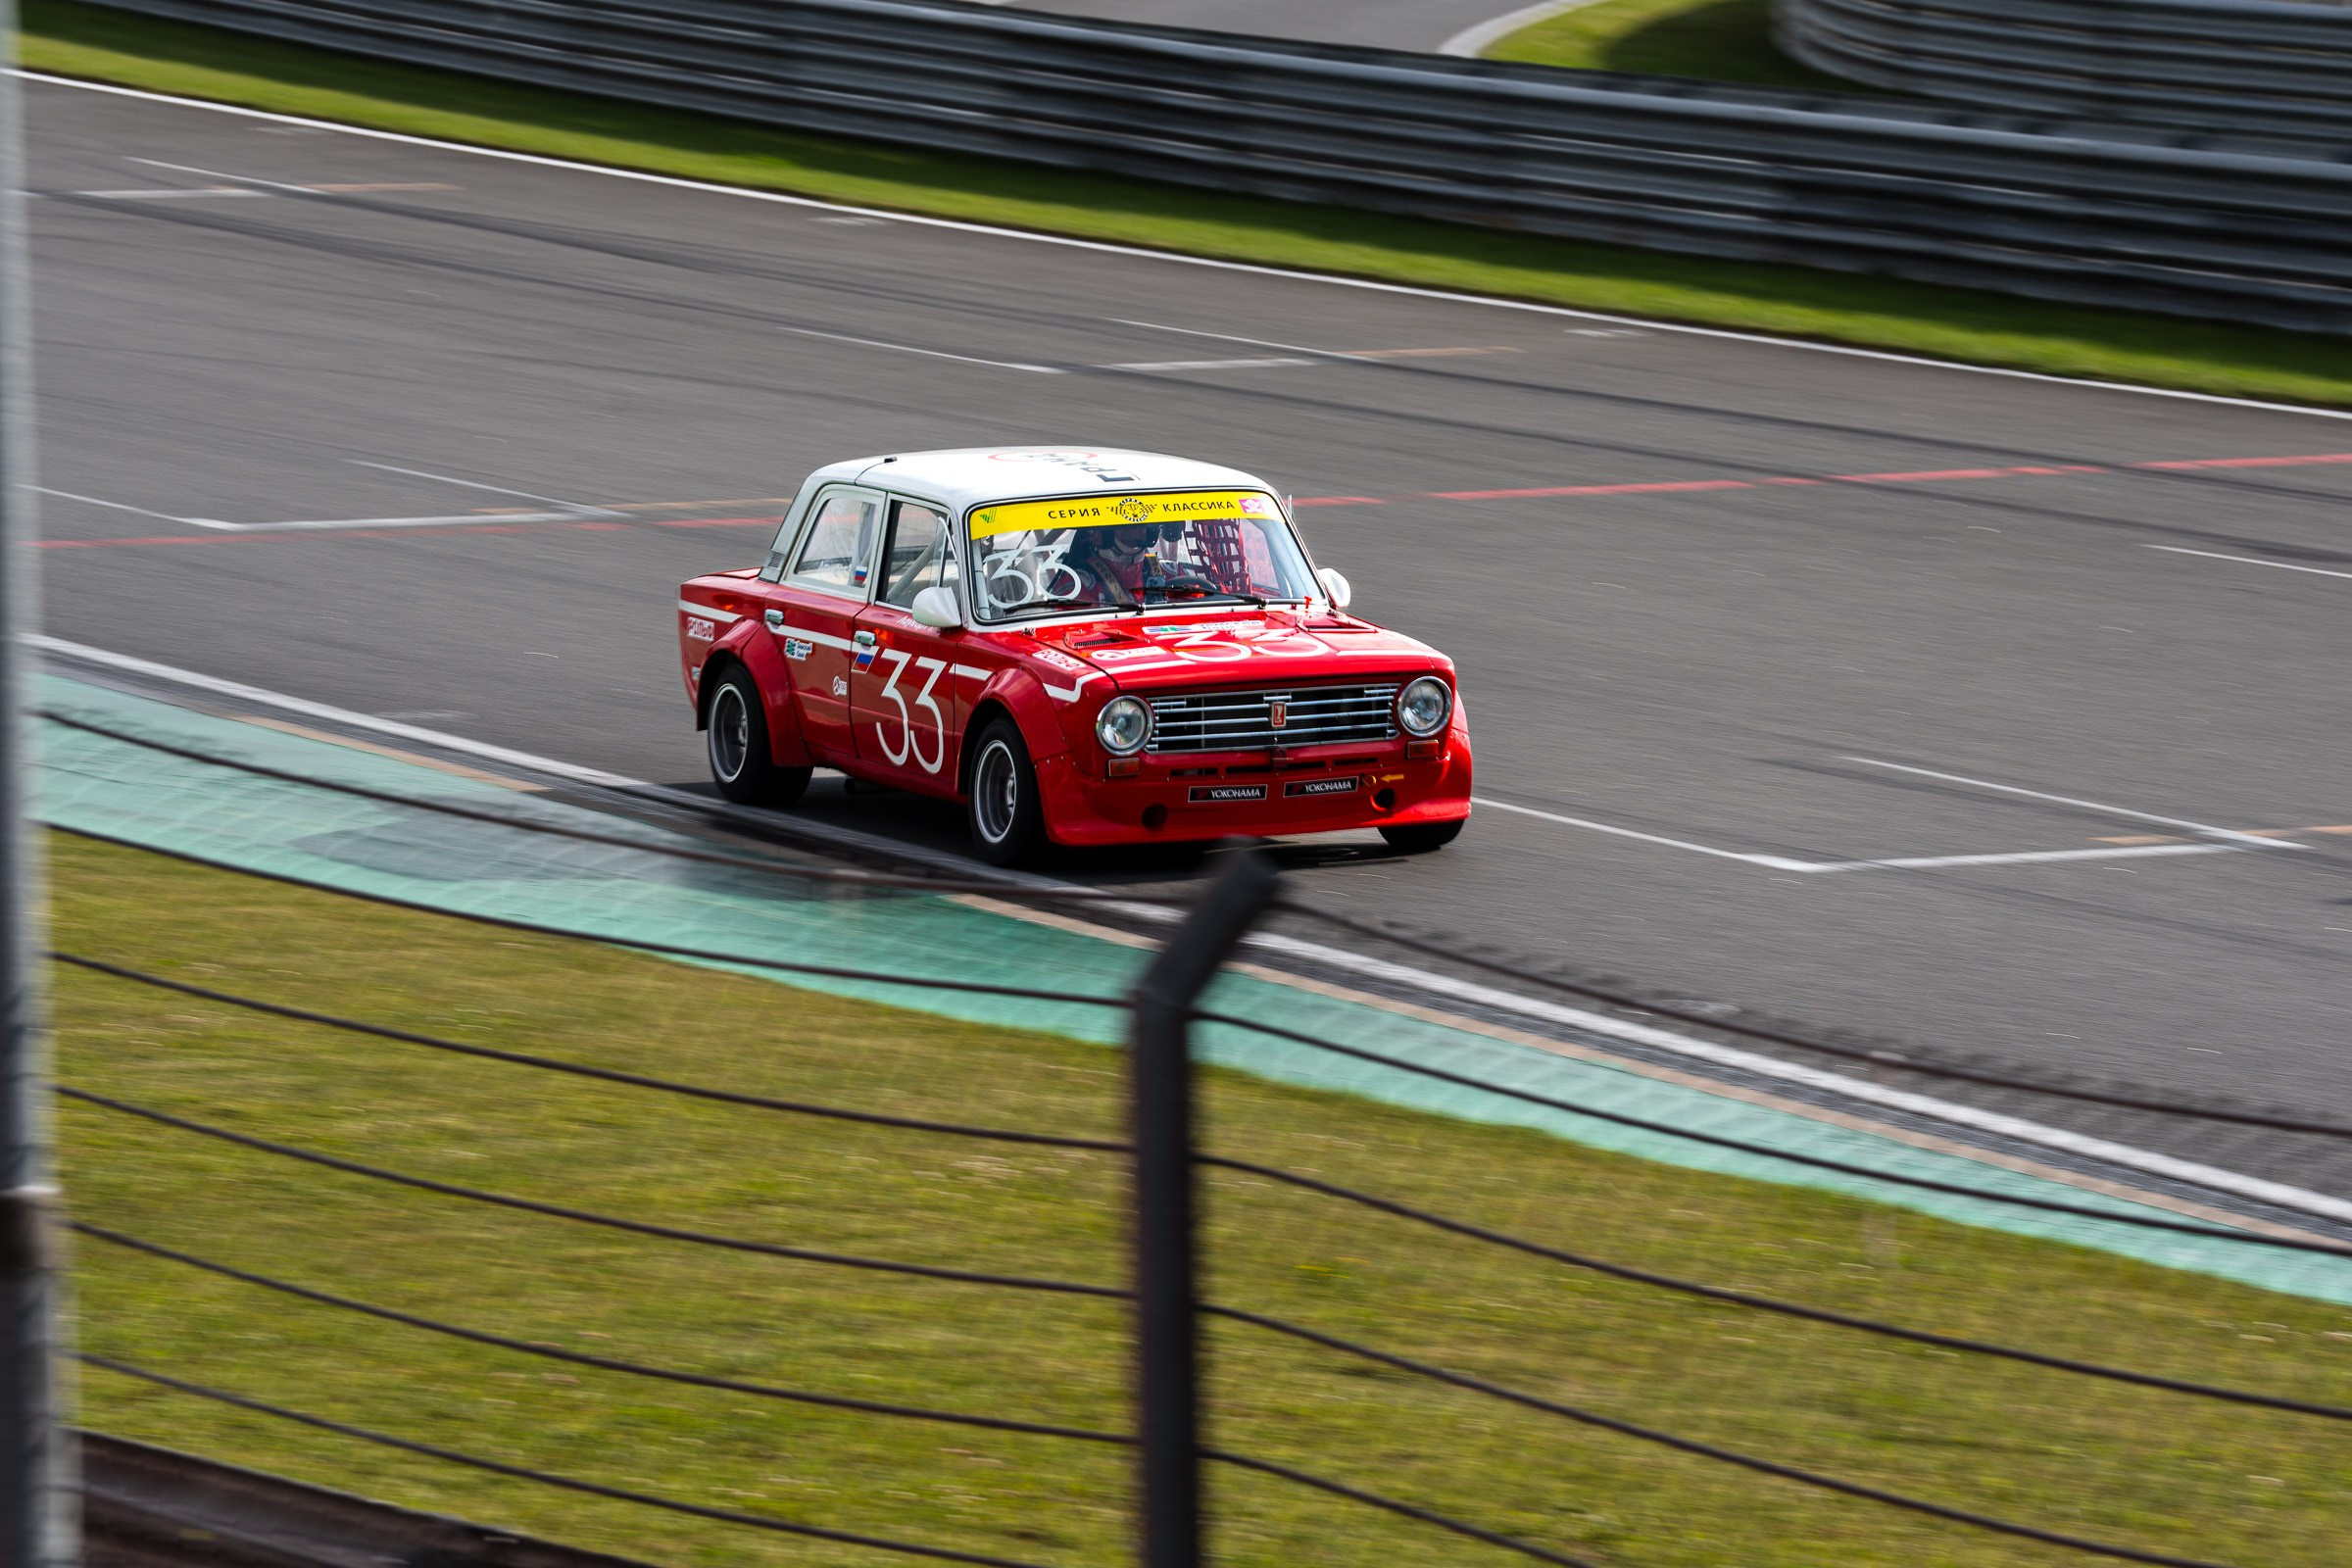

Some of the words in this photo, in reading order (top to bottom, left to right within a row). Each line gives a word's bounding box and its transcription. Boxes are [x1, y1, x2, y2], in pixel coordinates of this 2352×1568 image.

[1048, 507, 1101, 520] СЕРИЯ
[1162, 501, 1235, 513] КЛАССИКА
[982, 543, 1082, 610] 33
[1154, 628, 1330, 662] 33
[875, 648, 948, 774] 33
[1210, 788, 1260, 799] YOKOHAMA
[1304, 780, 1352, 793] YOKOHAMA
